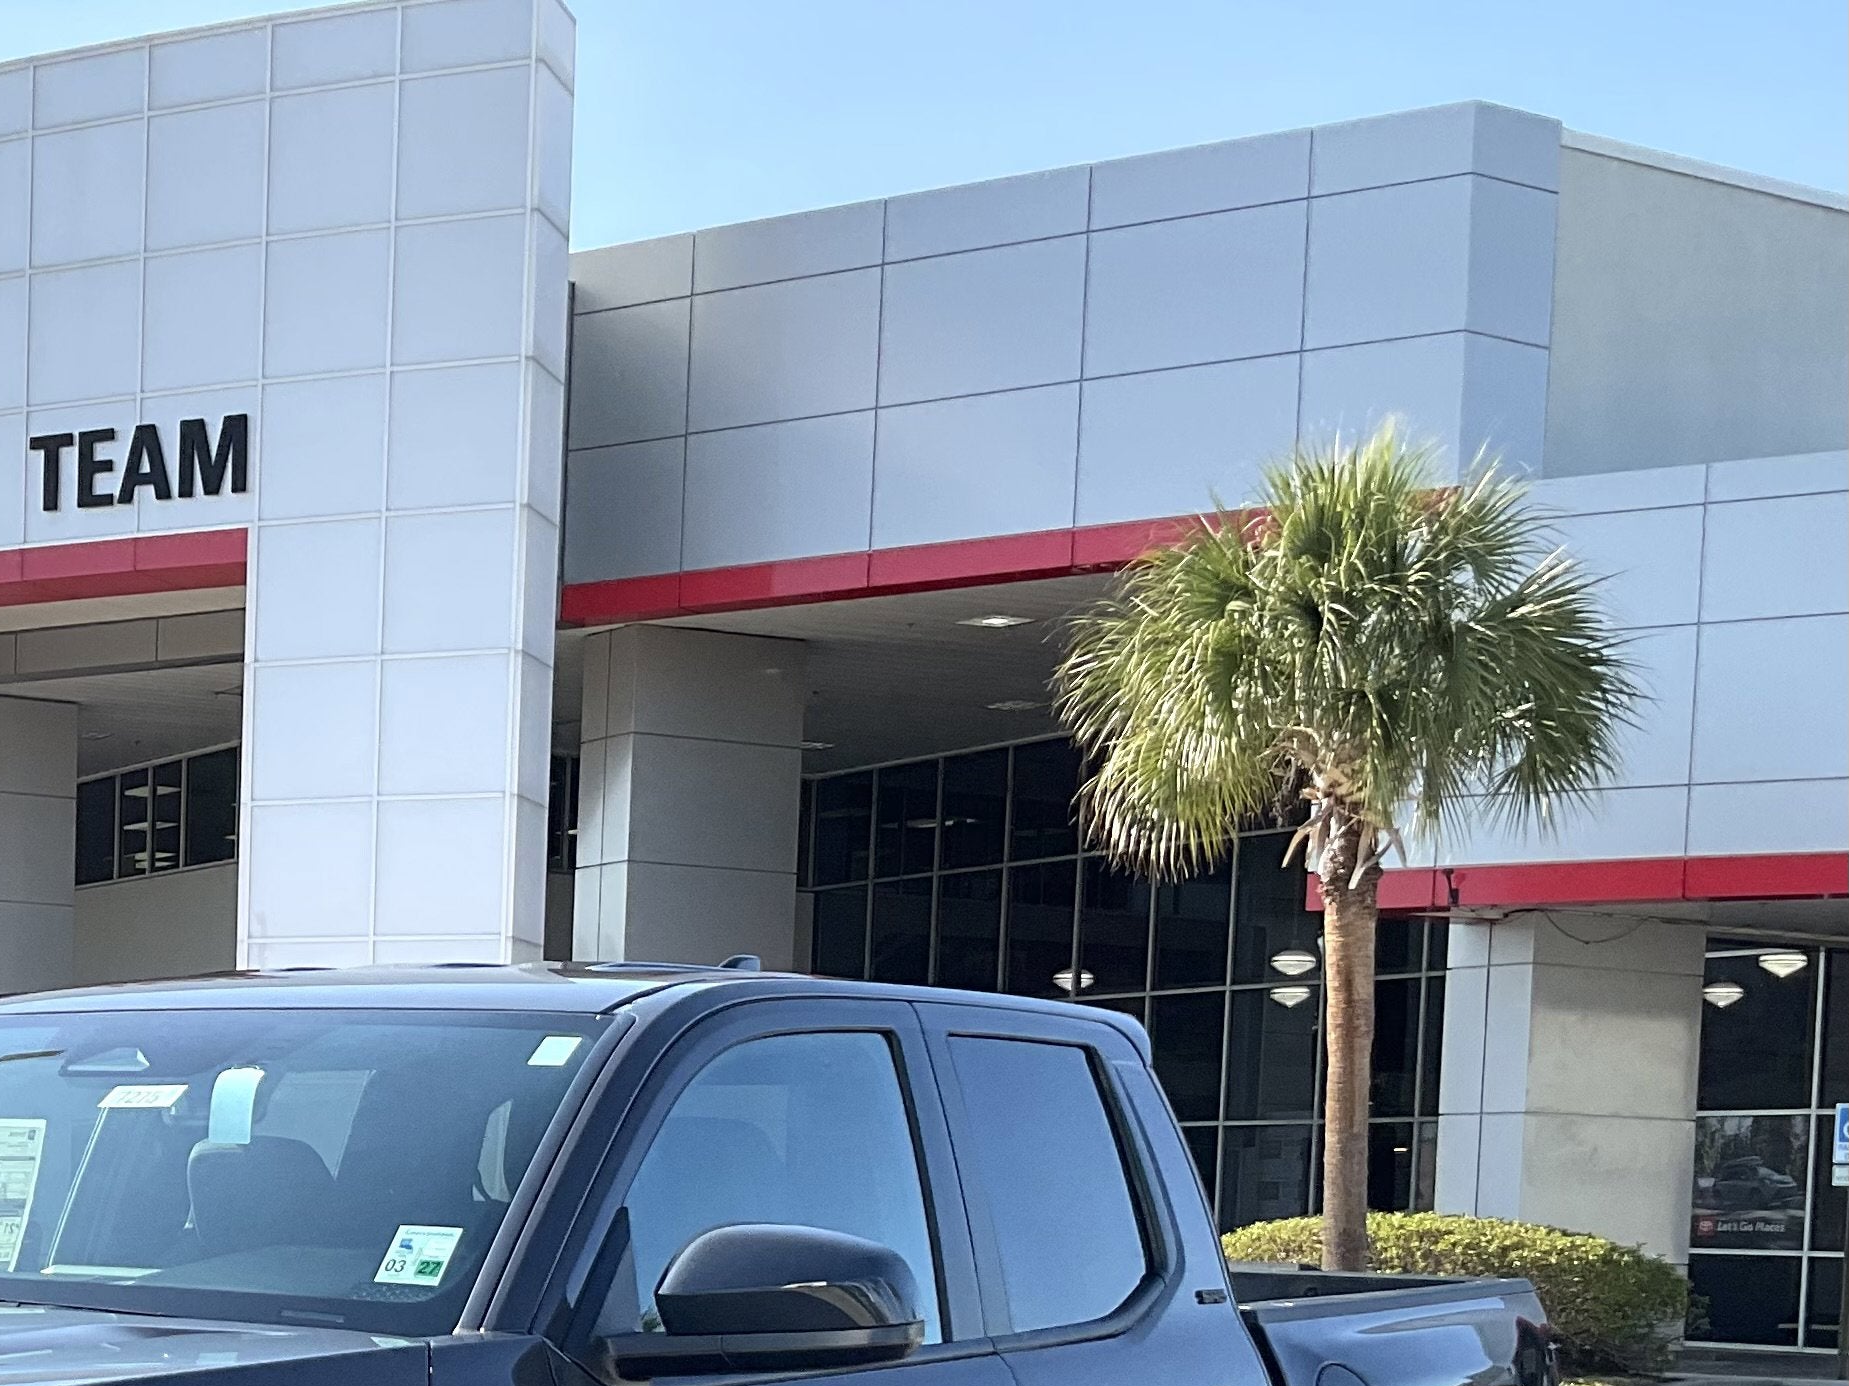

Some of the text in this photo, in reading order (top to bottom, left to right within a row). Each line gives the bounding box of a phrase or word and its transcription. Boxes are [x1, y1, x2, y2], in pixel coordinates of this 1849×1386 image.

[30, 413, 248, 512] TEAM
[1739, 1221, 1754, 1232] Go
[1755, 1221, 1786, 1233] Places
[384, 1259, 441, 1275] 03 27
